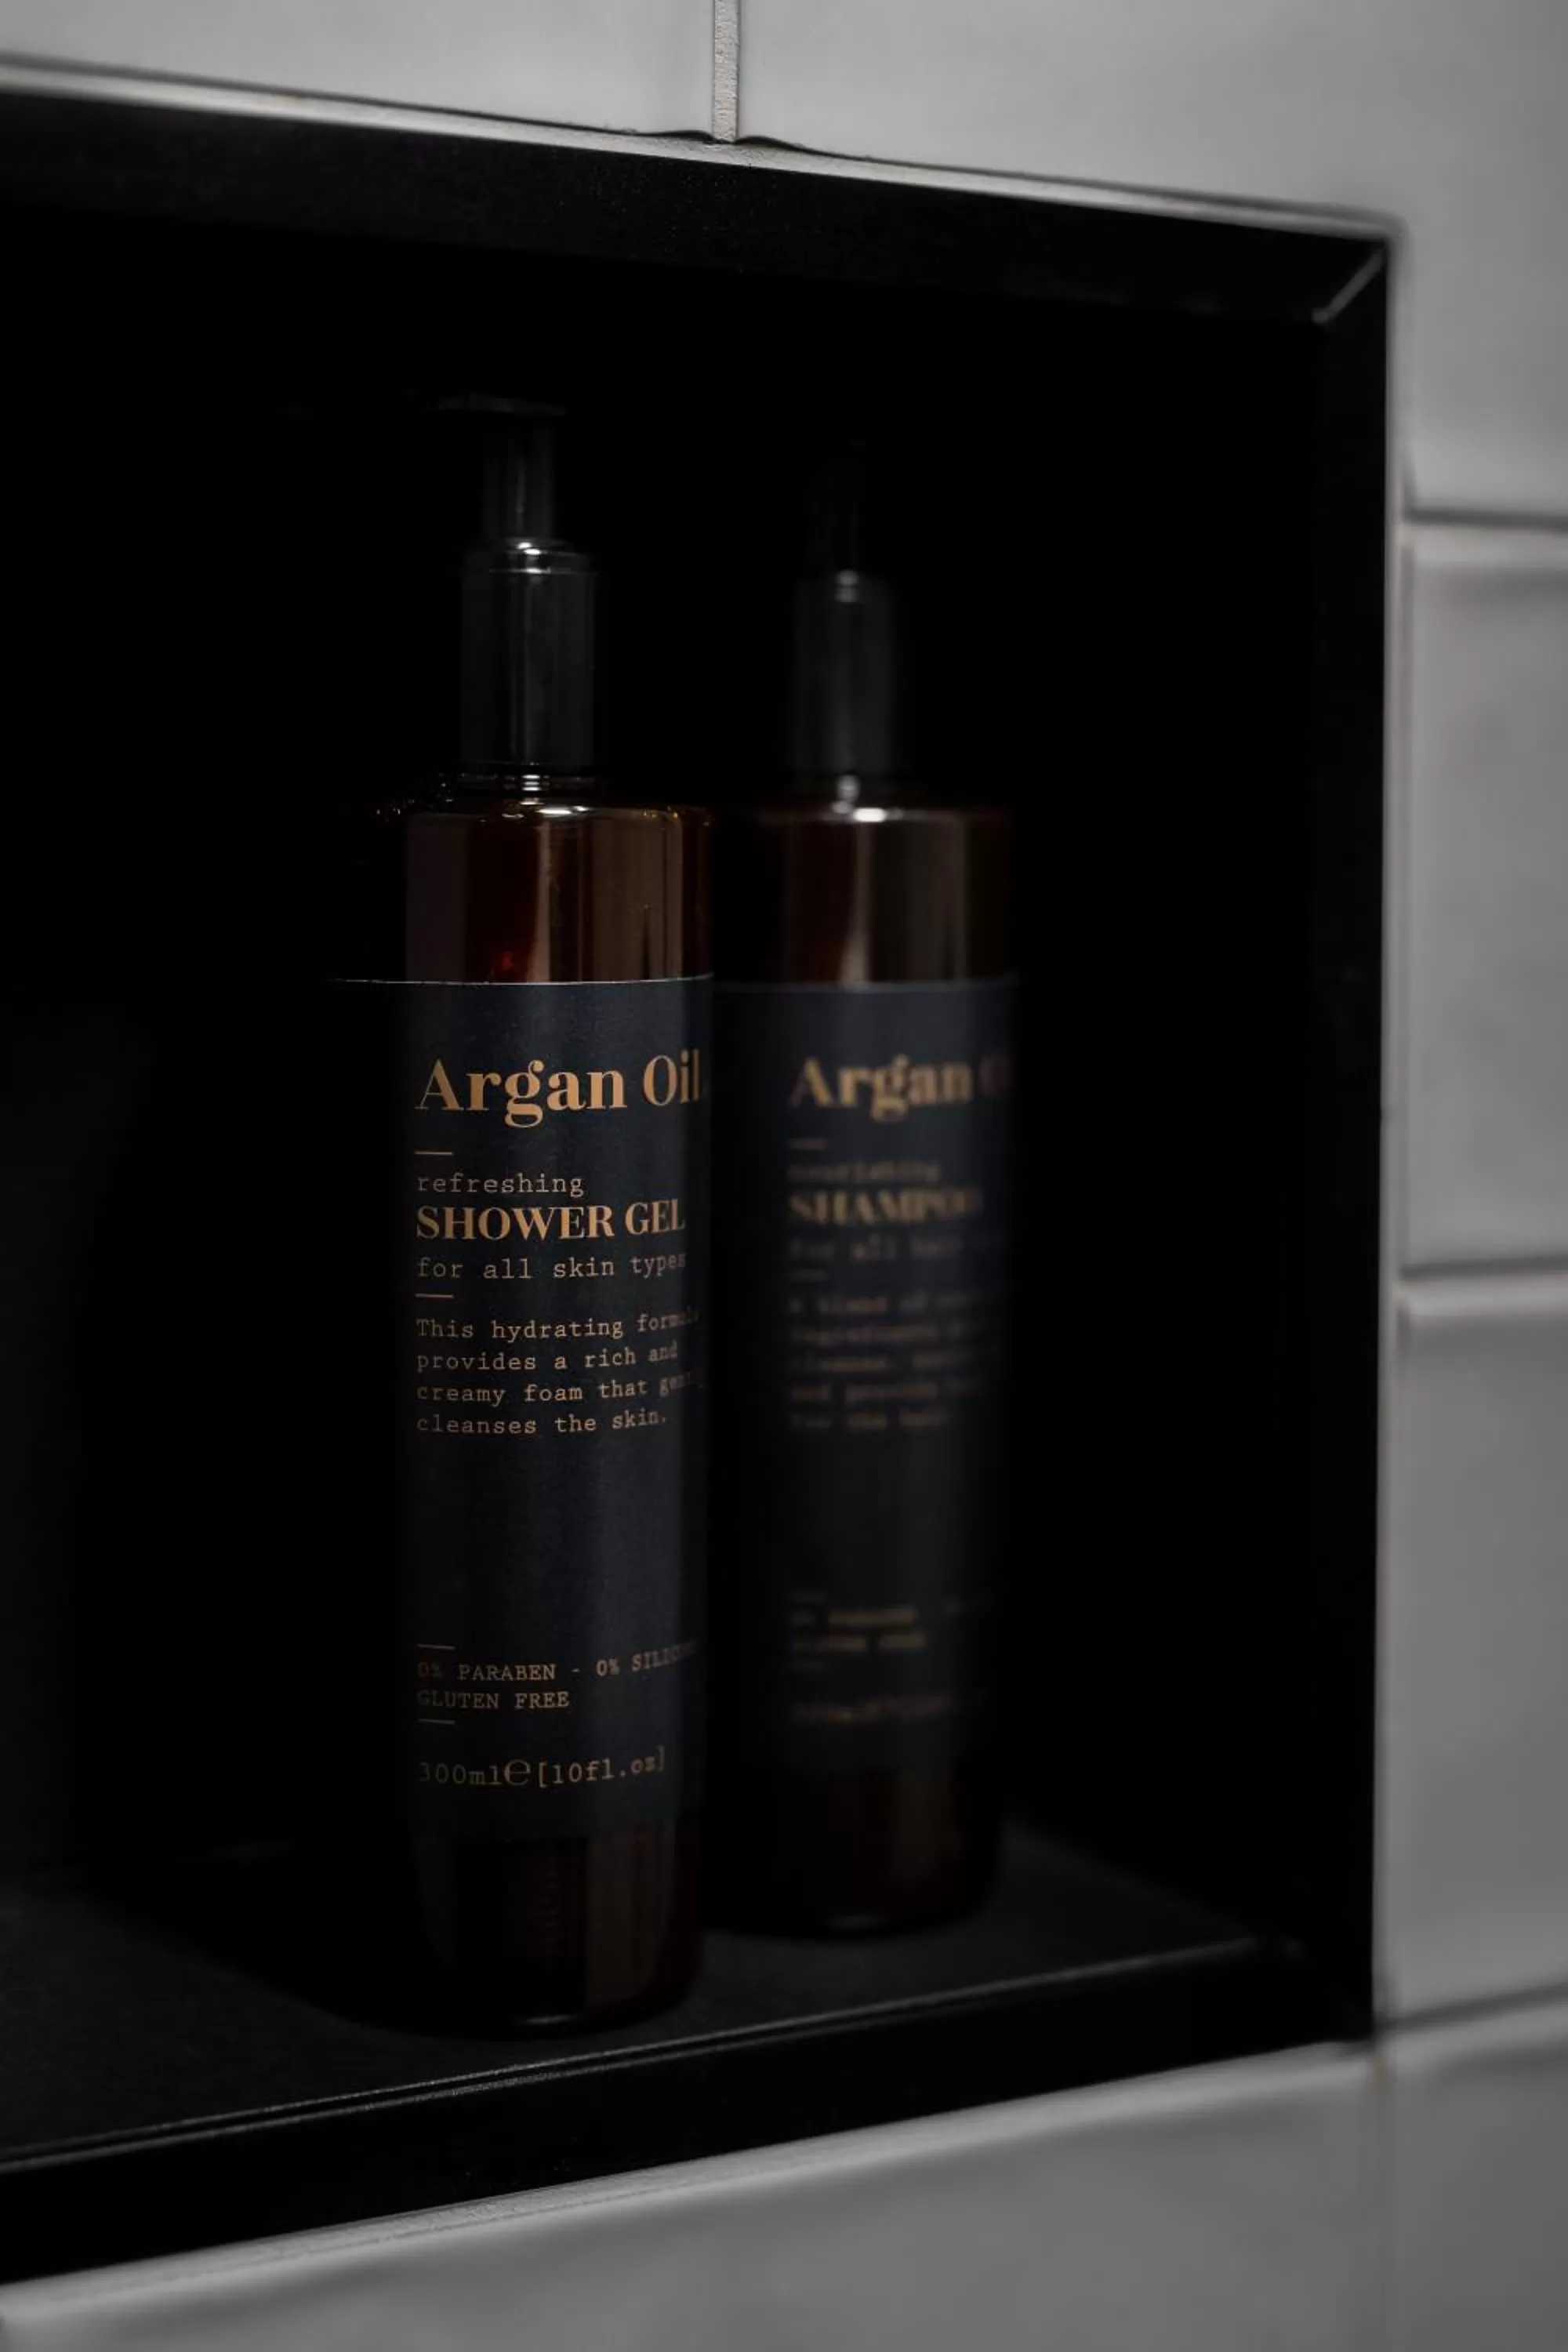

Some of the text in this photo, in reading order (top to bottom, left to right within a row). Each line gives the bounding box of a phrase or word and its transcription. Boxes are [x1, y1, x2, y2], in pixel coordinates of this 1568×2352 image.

[413, 1047, 701, 1129] Argan Oil
[786, 1054, 975, 1124] Argan
[416, 1172, 585, 1198] refreshing
[416, 1198, 686, 1241] SHOWER GEL
[416, 1253, 687, 1280] for all skin types
[416, 1306, 699, 1343] This hydrating form
[416, 1339, 679, 1374] provides a rich and
[416, 1385, 506, 1408] creamy
[523, 1385, 583, 1403] foam
[598, 1378, 648, 1399] that
[416, 1408, 667, 1436] cleanses the skin.
[417, 1661, 445, 1680] 0%
[456, 1663, 557, 1682] PARABEN
[596, 1658, 621, 1677] 0%
[630, 1639, 698, 1673] SILIC
[416, 1690, 571, 1711] GLUTEN FREE
